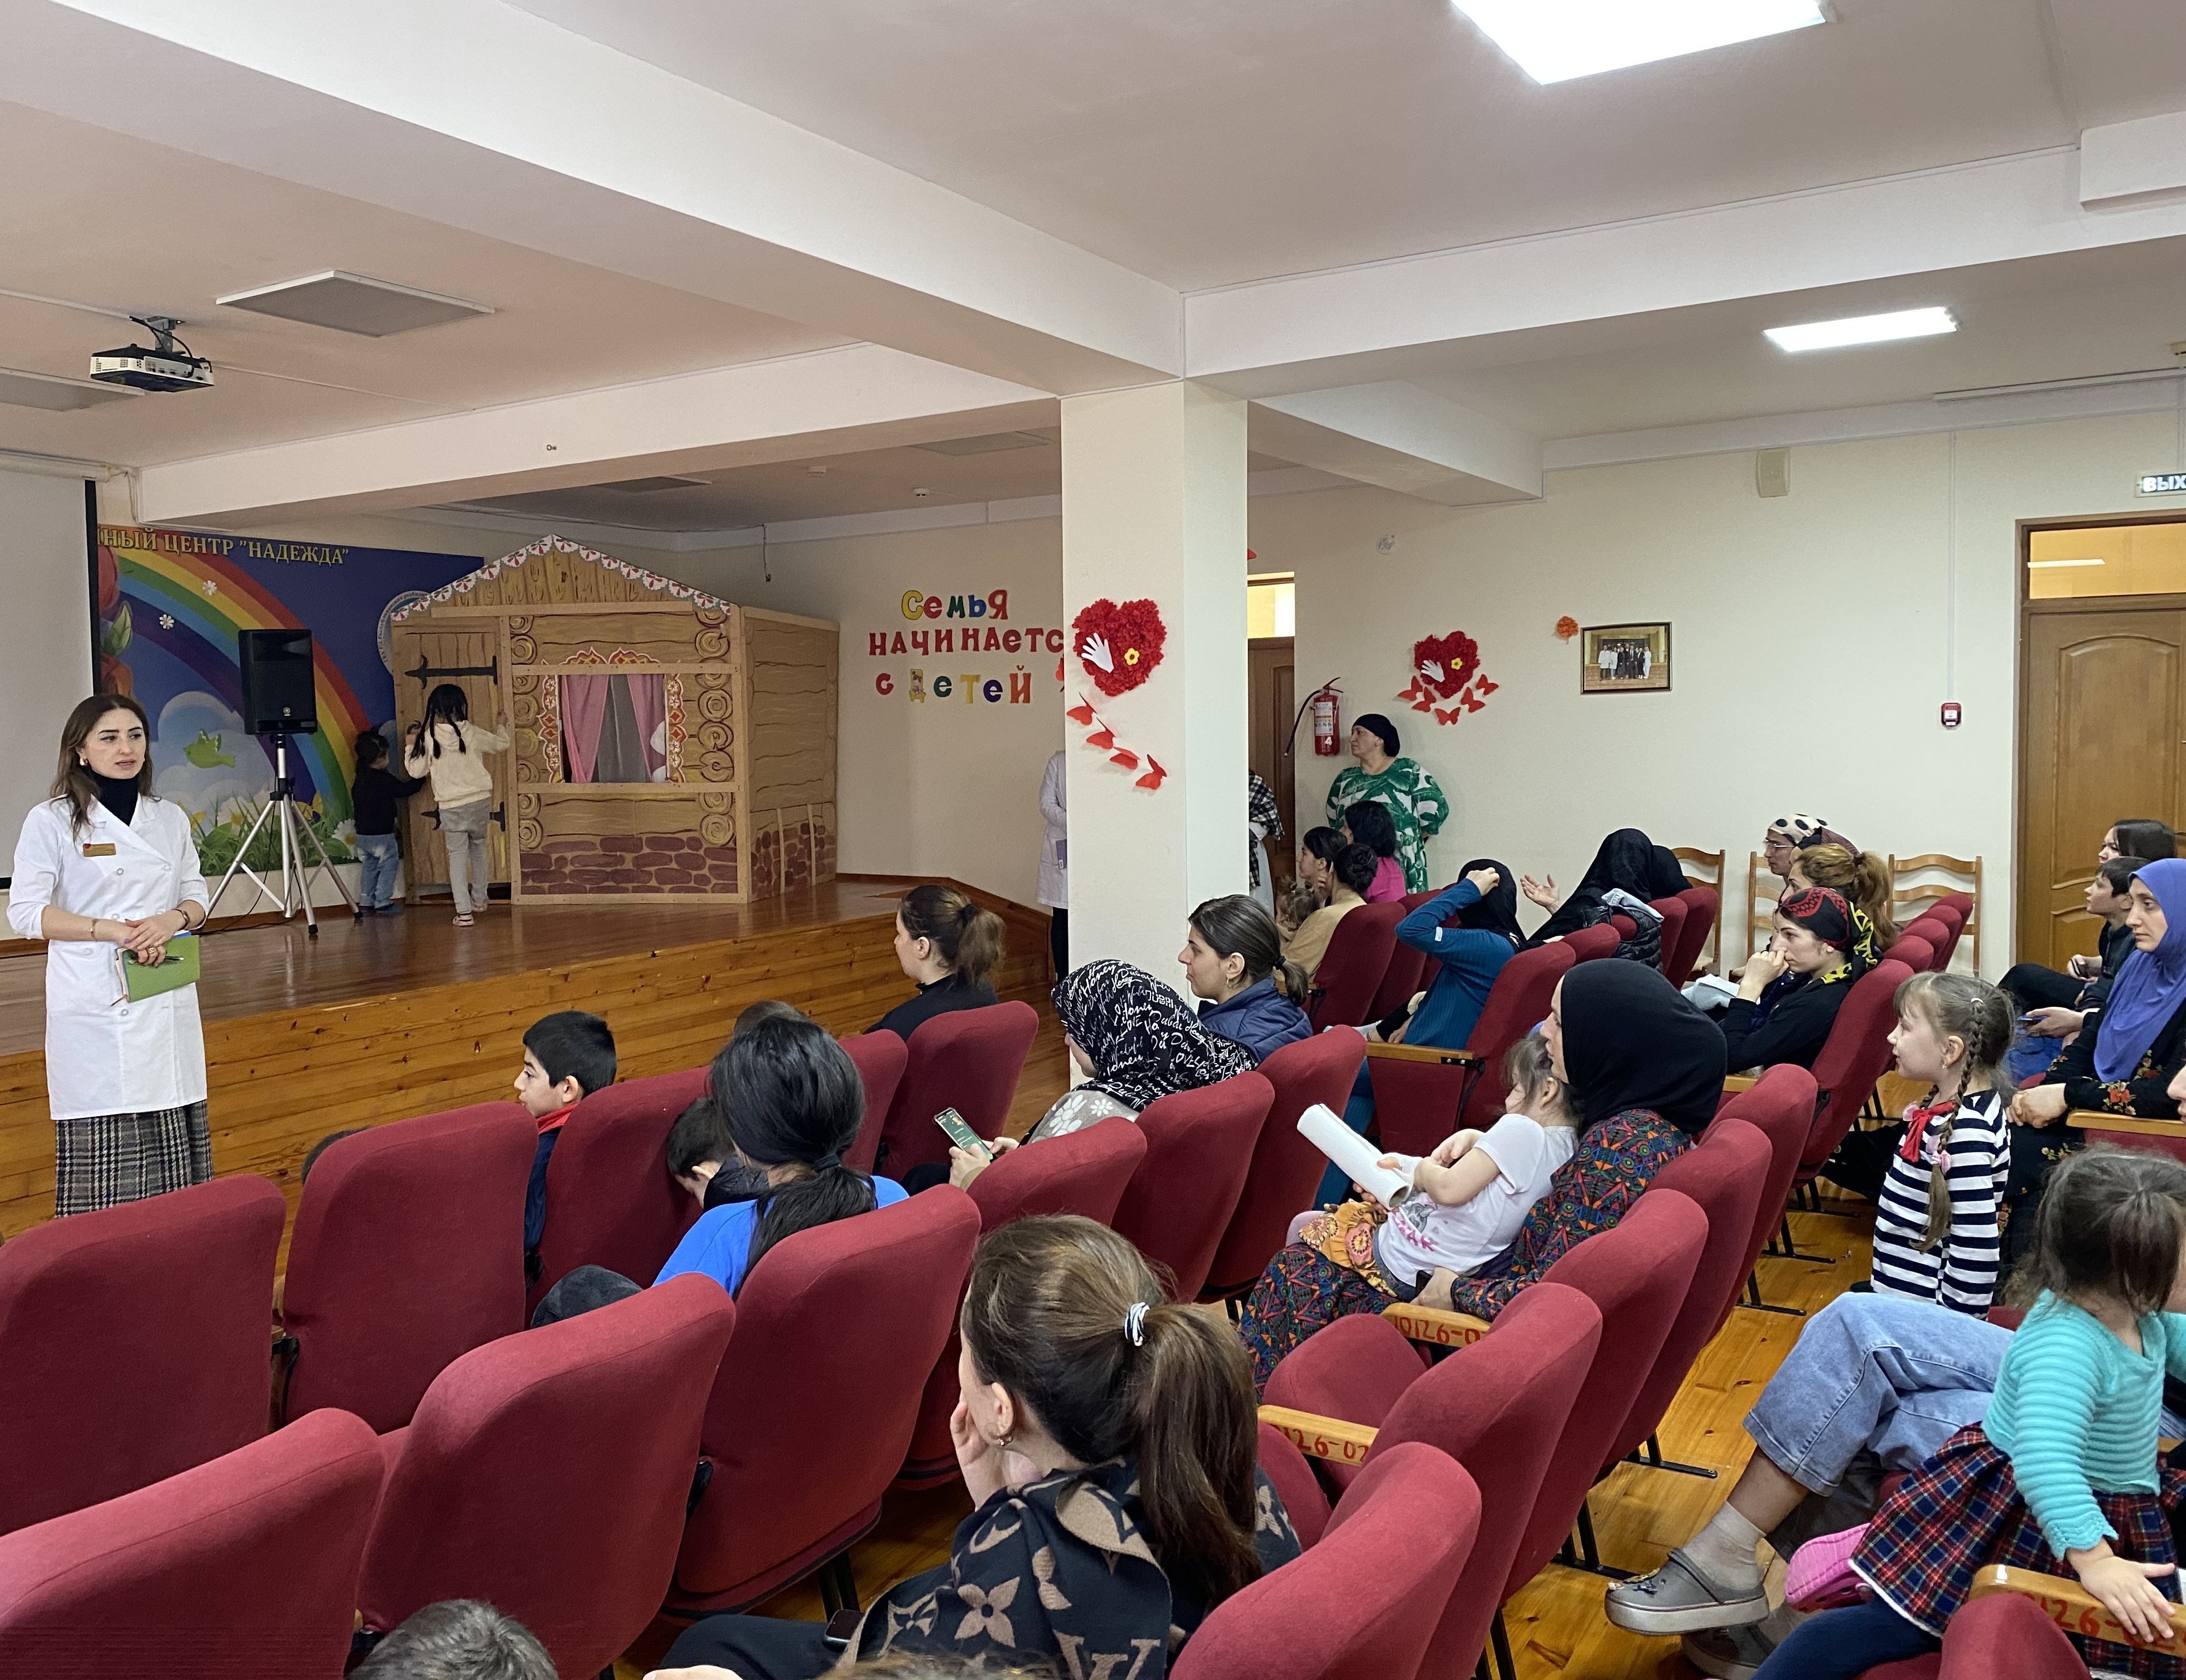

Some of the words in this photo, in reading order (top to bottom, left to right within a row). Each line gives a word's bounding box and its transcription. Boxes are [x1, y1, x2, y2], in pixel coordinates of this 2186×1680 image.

[97, 527, 157, 550] НЫЙ
[164, 534, 234, 556] ЦЕНТР
[239, 541, 349, 567] "НАДЕЖДА"
[1394, 1315, 1486, 1345] 10126-0
